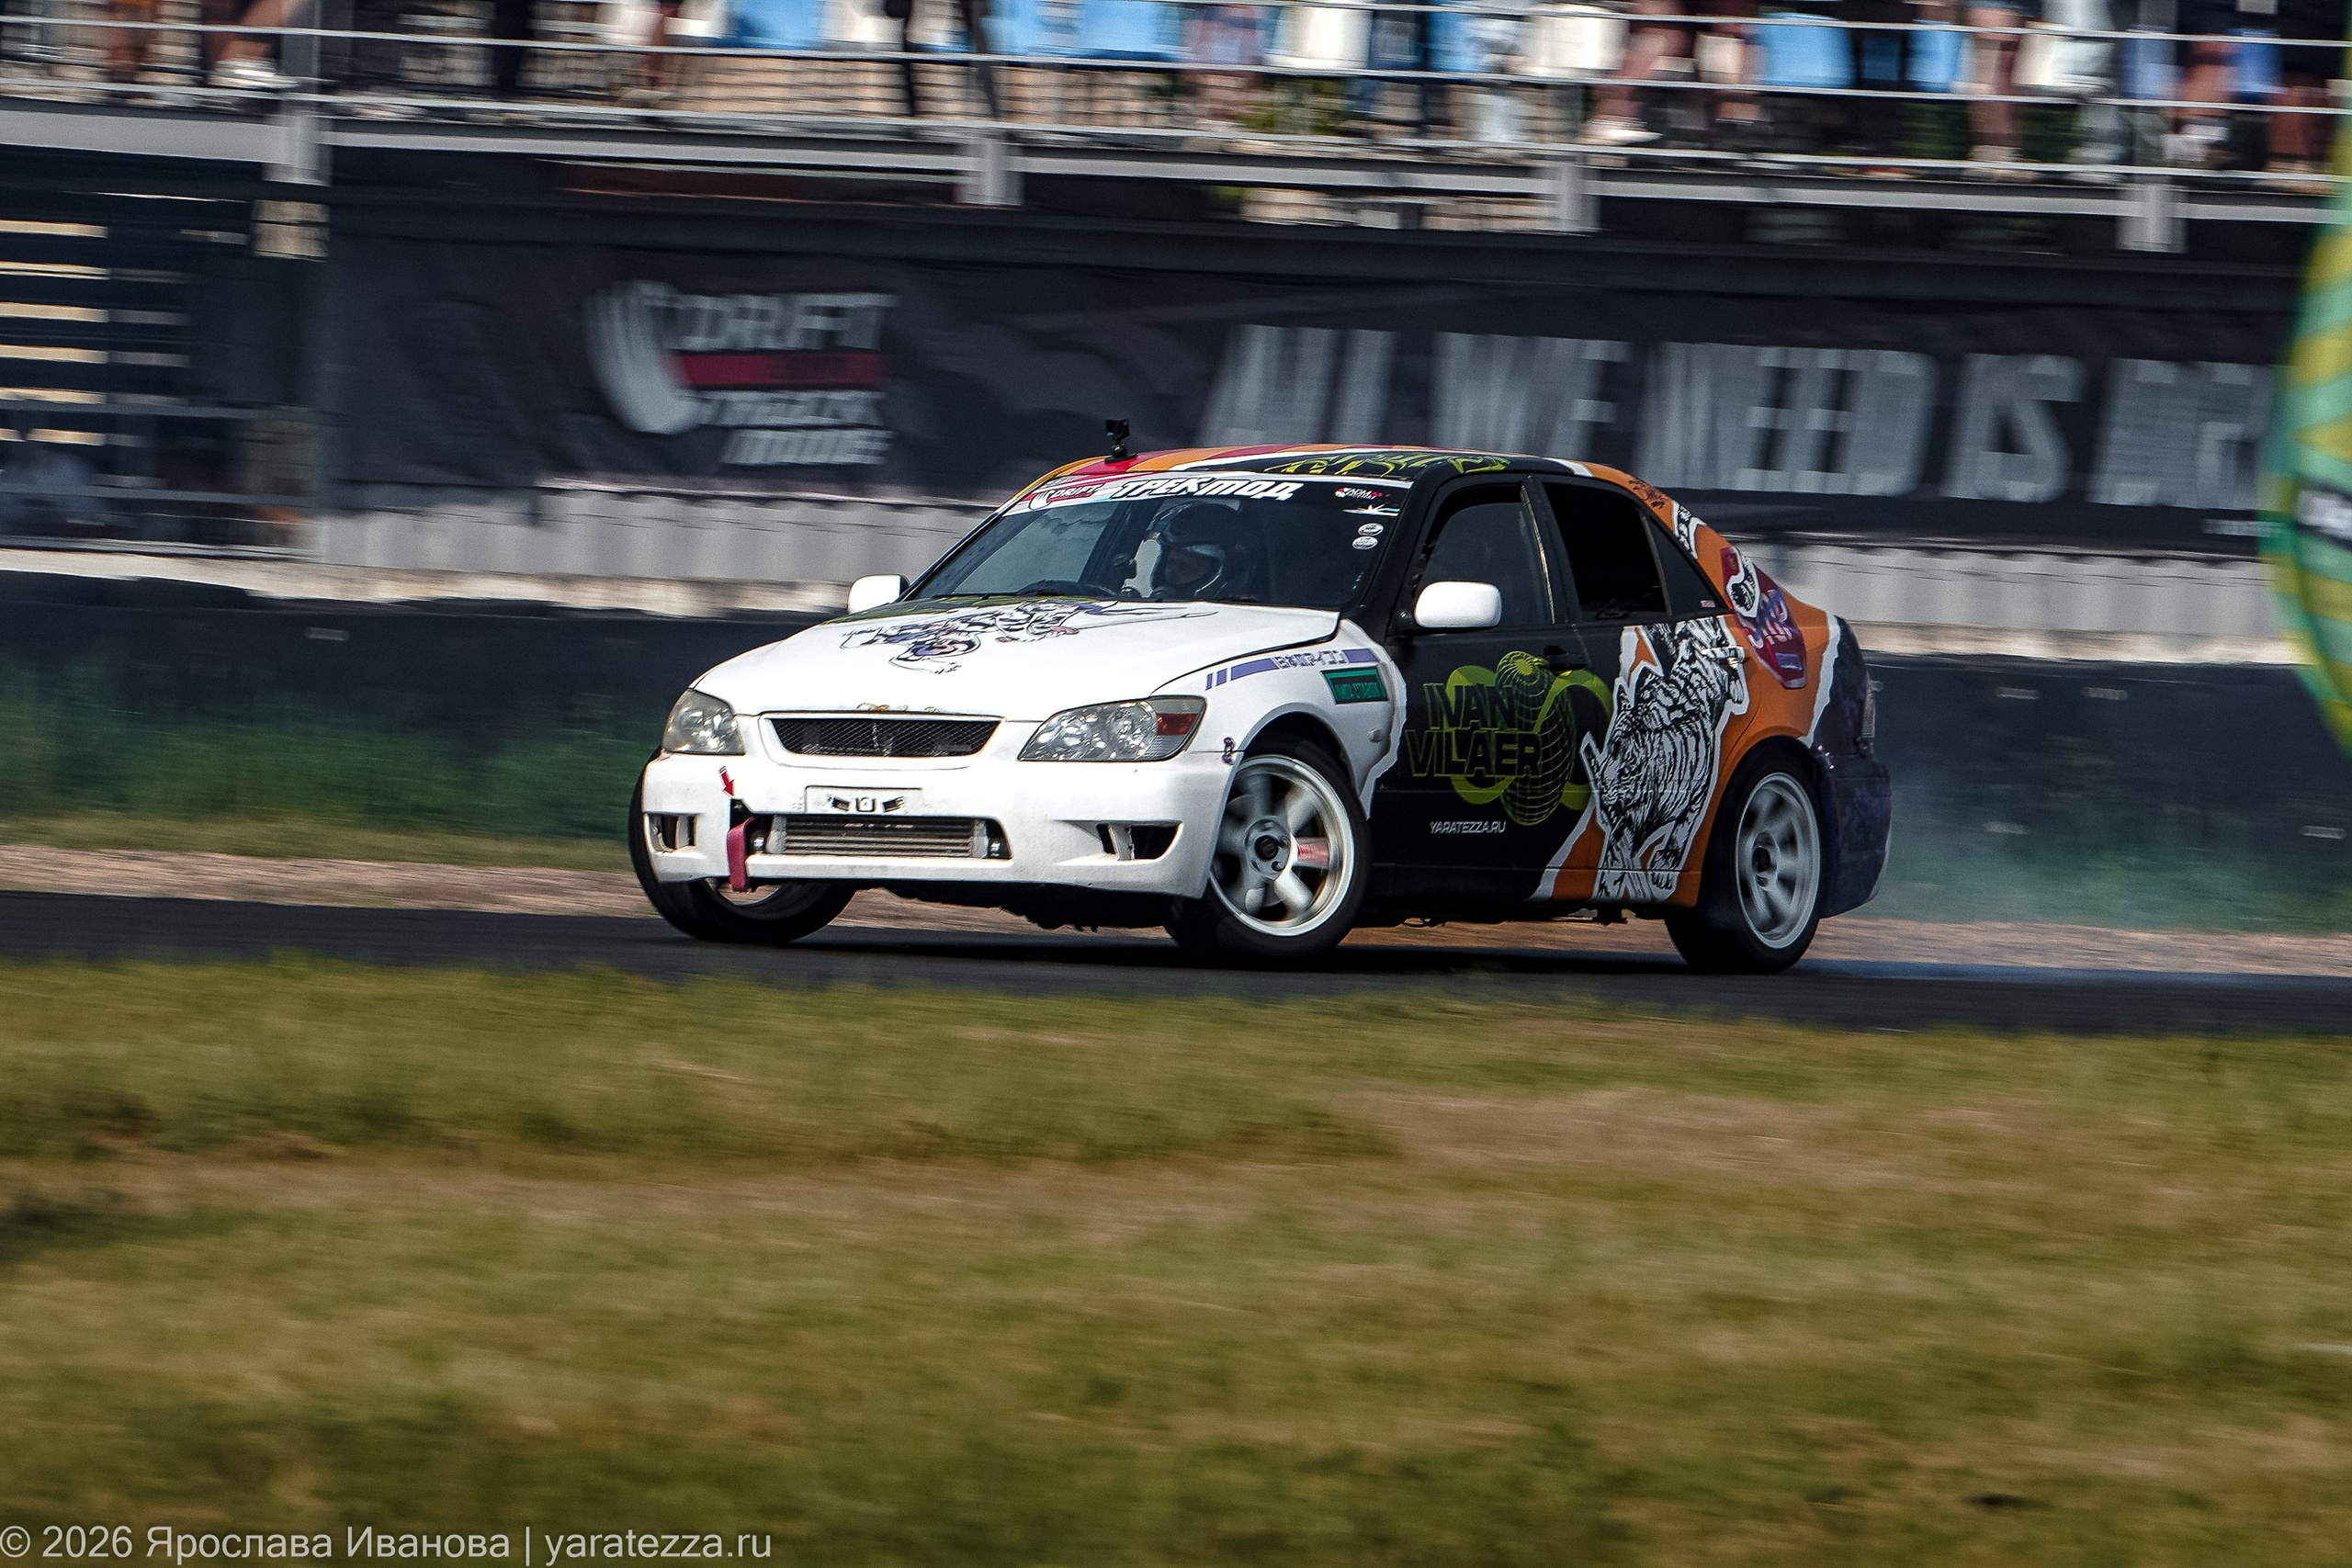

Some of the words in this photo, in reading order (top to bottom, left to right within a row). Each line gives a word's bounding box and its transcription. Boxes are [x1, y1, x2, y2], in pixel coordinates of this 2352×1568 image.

[1422, 682, 1519, 731] IVAN
[1404, 728, 1543, 778] VILAER
[1430, 820, 1507, 834] YARATEZZA.RU
